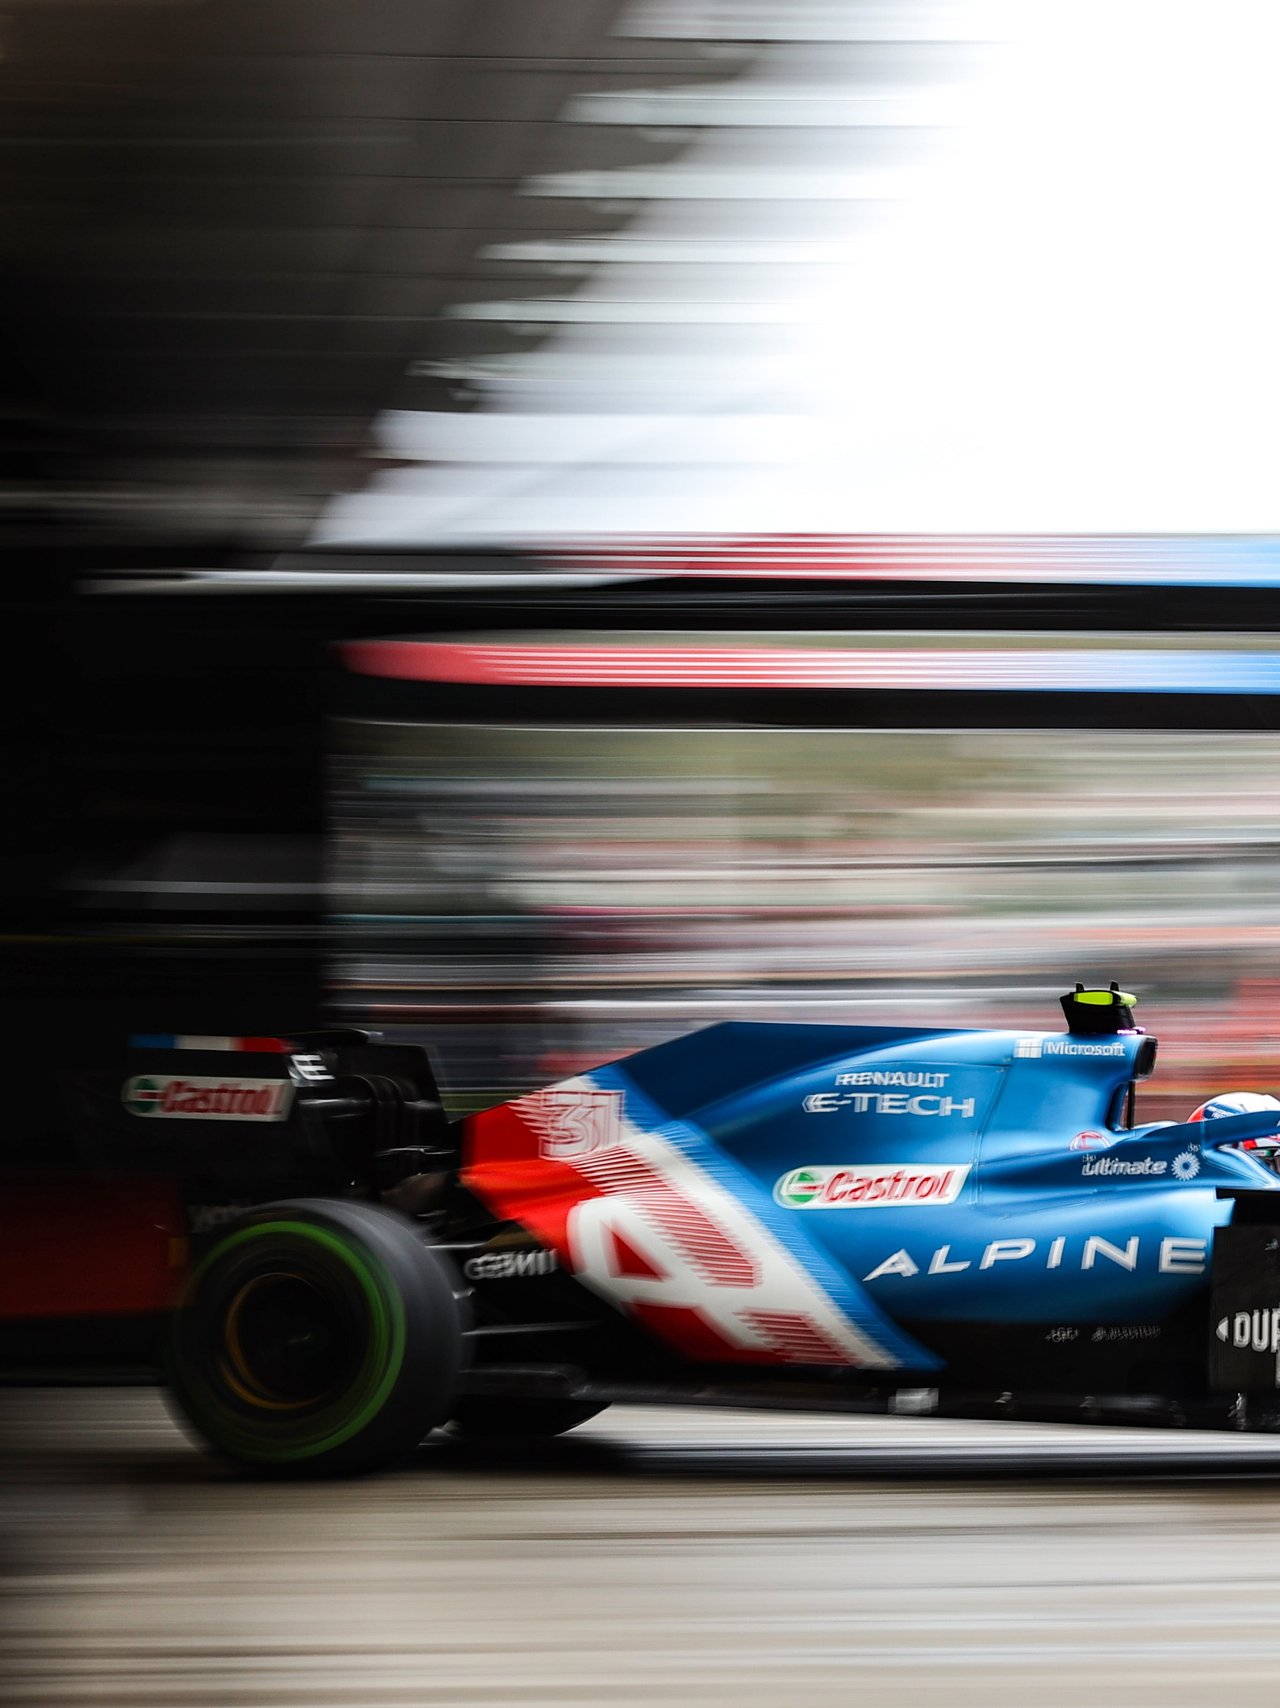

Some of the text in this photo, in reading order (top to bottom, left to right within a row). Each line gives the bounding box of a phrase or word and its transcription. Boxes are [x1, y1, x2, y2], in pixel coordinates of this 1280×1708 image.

[1045, 1042, 1126, 1057] Microsoft
[835, 1072, 950, 1088] RENAULT
[161, 1080, 284, 1115] Castrol
[824, 1170, 956, 1202] Castrol
[863, 1235, 1207, 1282] ALPINE
